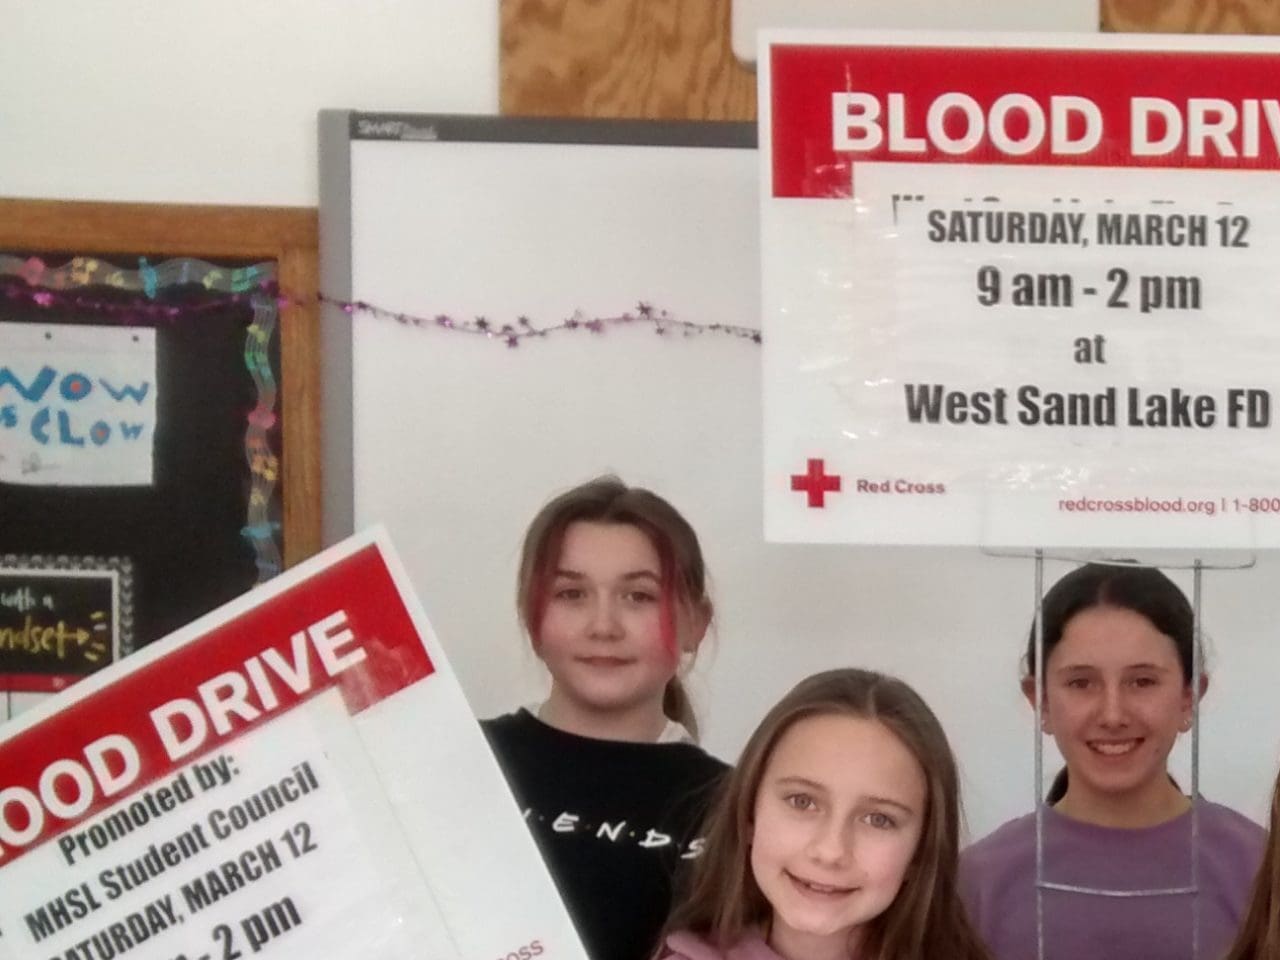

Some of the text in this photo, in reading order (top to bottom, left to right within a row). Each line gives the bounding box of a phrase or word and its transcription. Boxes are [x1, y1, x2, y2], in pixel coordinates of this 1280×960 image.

[833, 92, 1103, 156] BLOOD
[928, 209, 1250, 248] SATURDAY, MARCH 12
[977, 265, 1002, 307] 9
[1012, 272, 1073, 308] am
[1106, 267, 1130, 309] 2
[1140, 275, 1201, 314] pm
[1074, 334, 1106, 365] at
[904, 383, 1270, 429] West Sand Lake FD
[856, 479, 946, 495] Red Cross
[1058, 496, 1216, 516] redcrossblood.org
[0, 613, 68, 659] ndset
[0, 609, 367, 851] OOD DRIVE
[58, 754, 240, 867] Promoted by:
[24, 761, 320, 942] MHSL Student Council
[180, 839, 283, 914] MARCH
[280, 821, 318, 859] 12
[240, 896, 302, 953] pm
